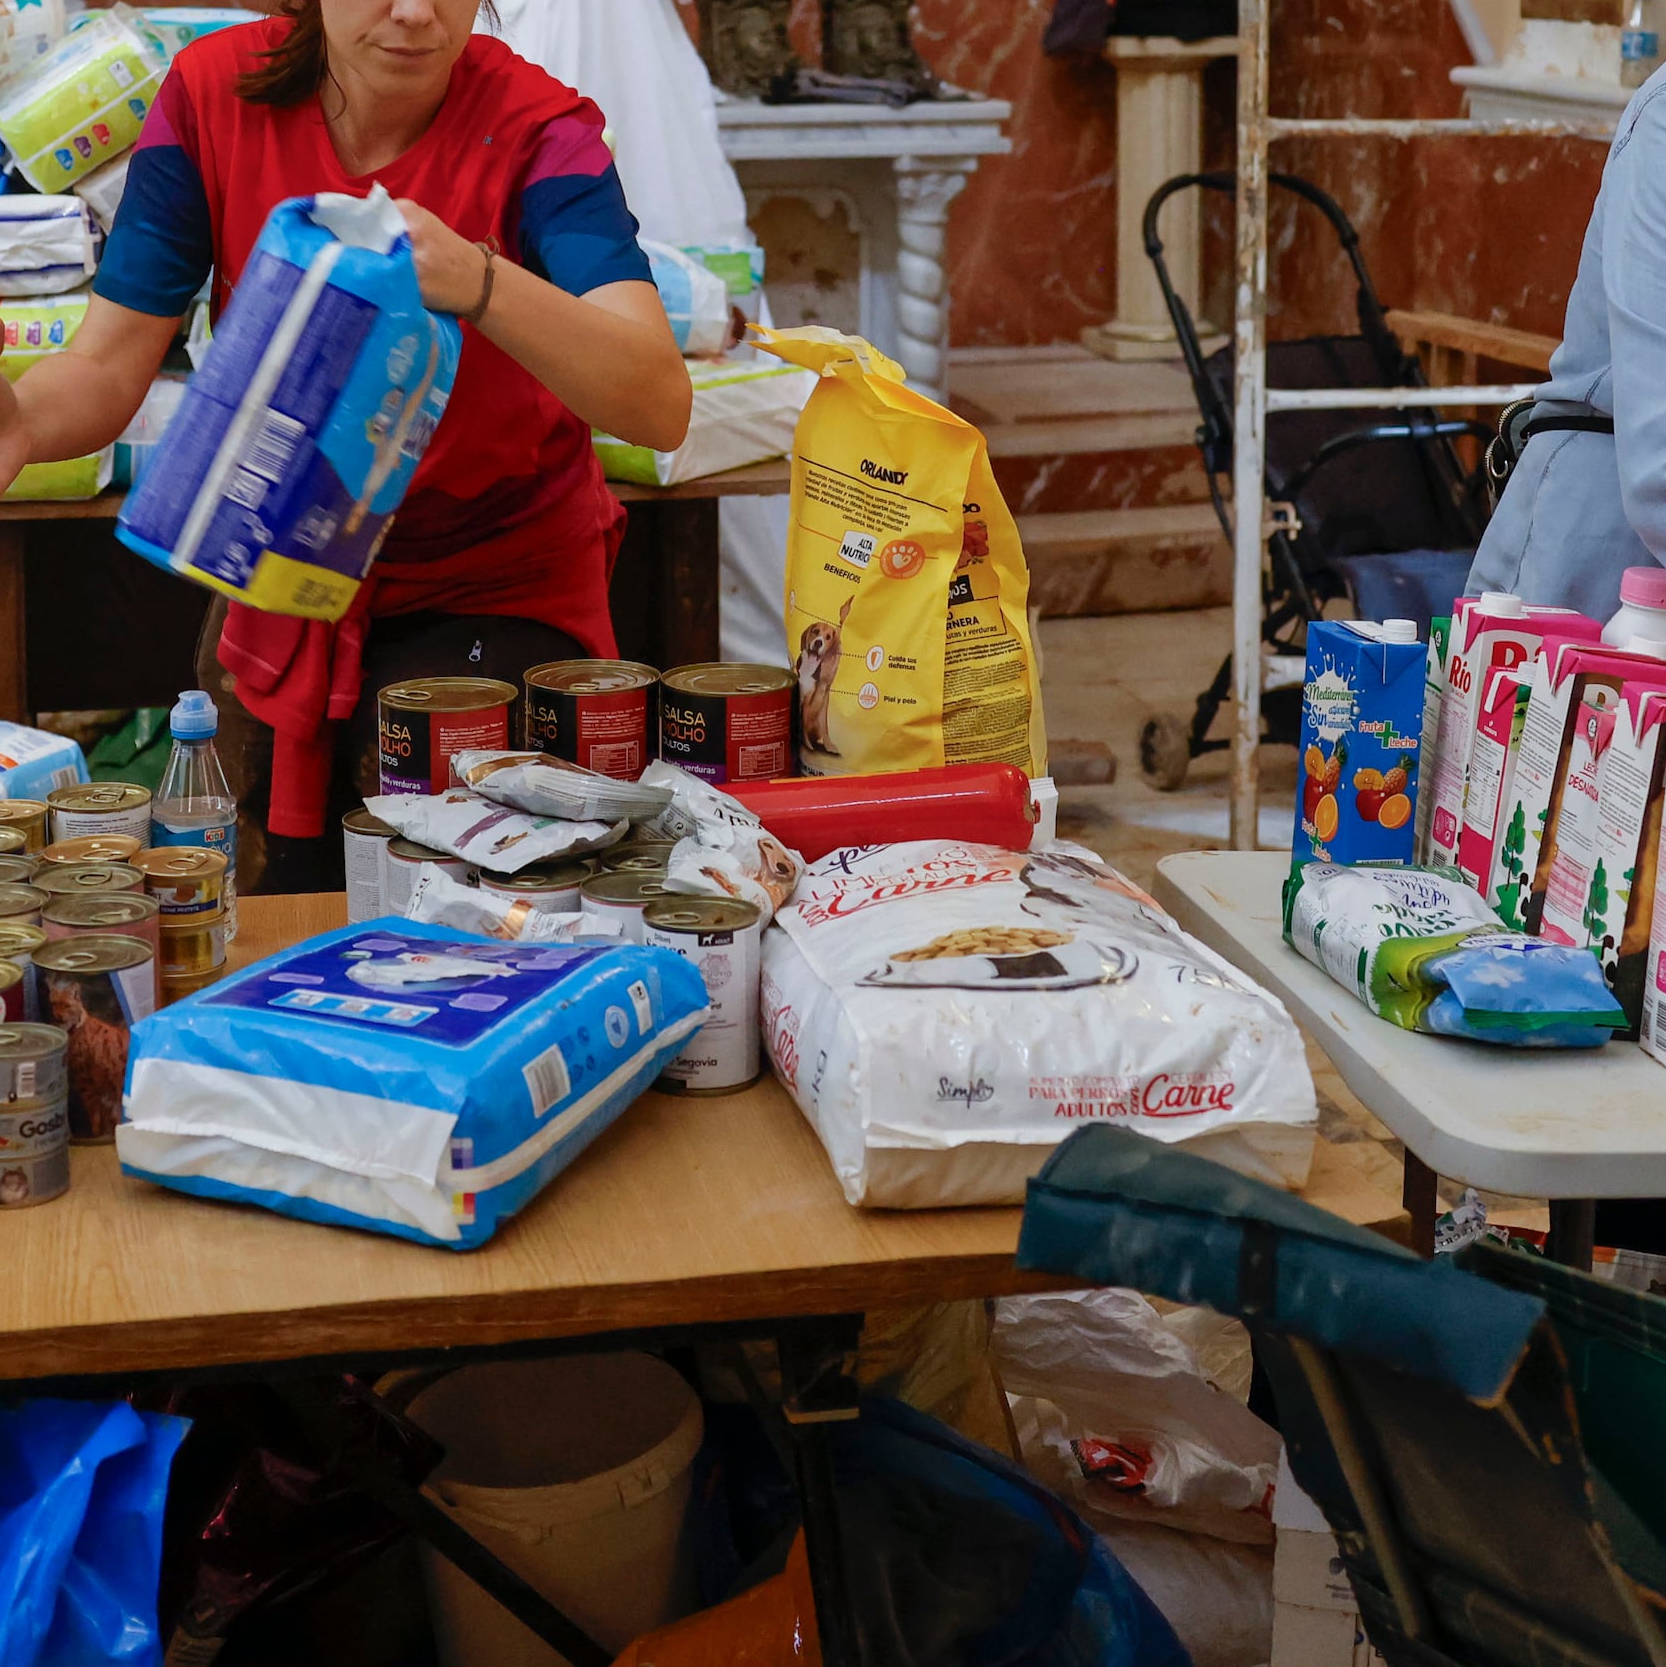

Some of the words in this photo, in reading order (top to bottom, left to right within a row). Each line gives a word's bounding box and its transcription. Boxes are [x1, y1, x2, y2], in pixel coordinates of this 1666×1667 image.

[968, 625, 998, 636] verduras
[1448, 654, 1472, 694] Río
[664, 703, 706, 727] SALSA
[1359, 720, 1384, 733] Fruta
[1389, 736, 1418, 749] Leche
[684, 762, 716, 775] verduras
[392, 778, 421, 790] verduras
[676, 1056, 718, 1070] Segovia
[1142, 1073, 1235, 1117] Carne
[1055, 1101, 1130, 1118] ADULTOS
